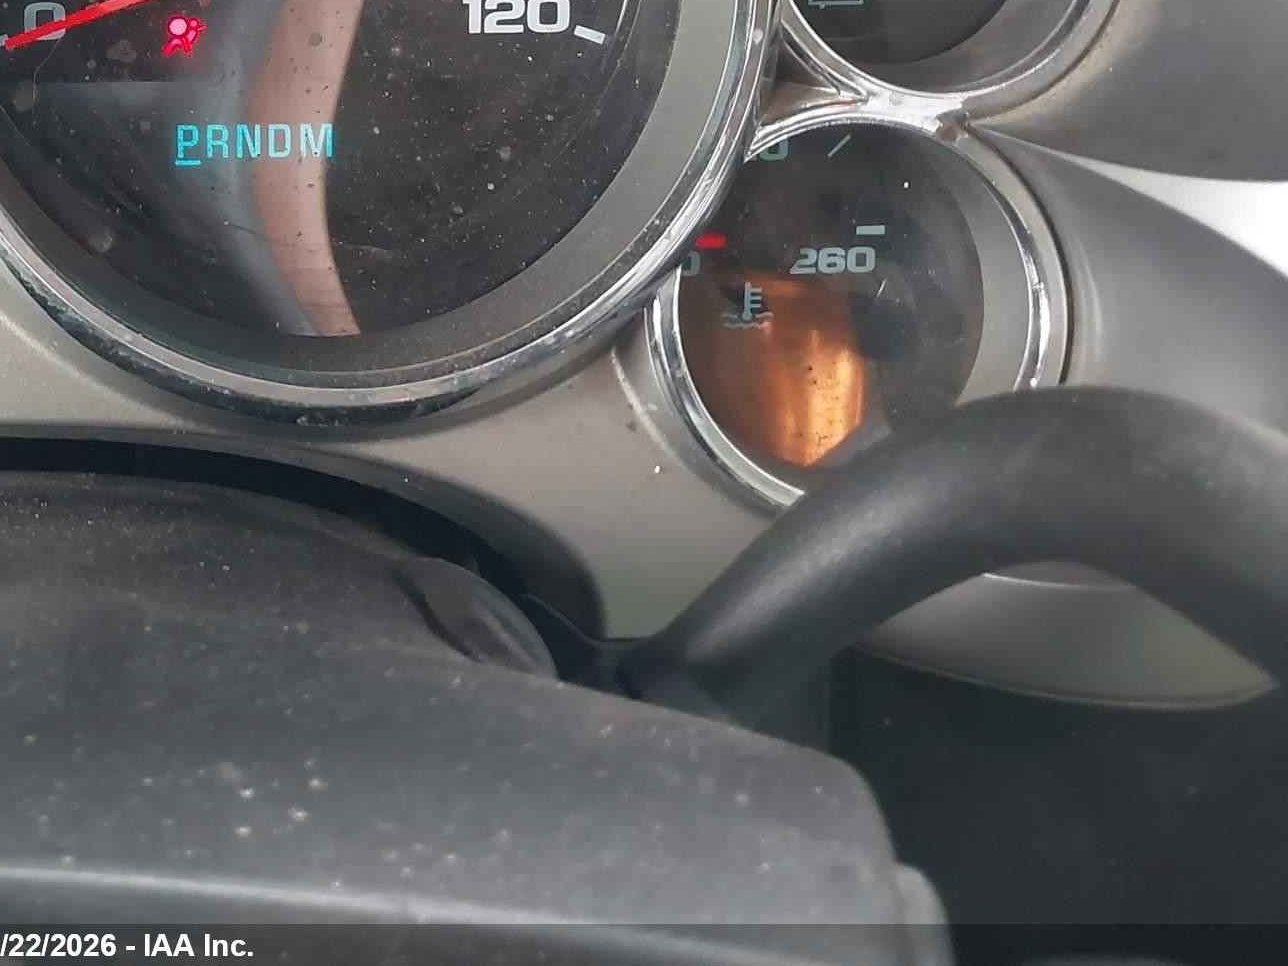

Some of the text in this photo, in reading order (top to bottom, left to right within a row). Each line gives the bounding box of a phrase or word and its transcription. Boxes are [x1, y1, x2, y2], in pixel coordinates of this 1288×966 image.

[24, 1, 66, 40] 0
[176, 124, 334, 160] PRNDM
[789, 246, 876, 275] 260
